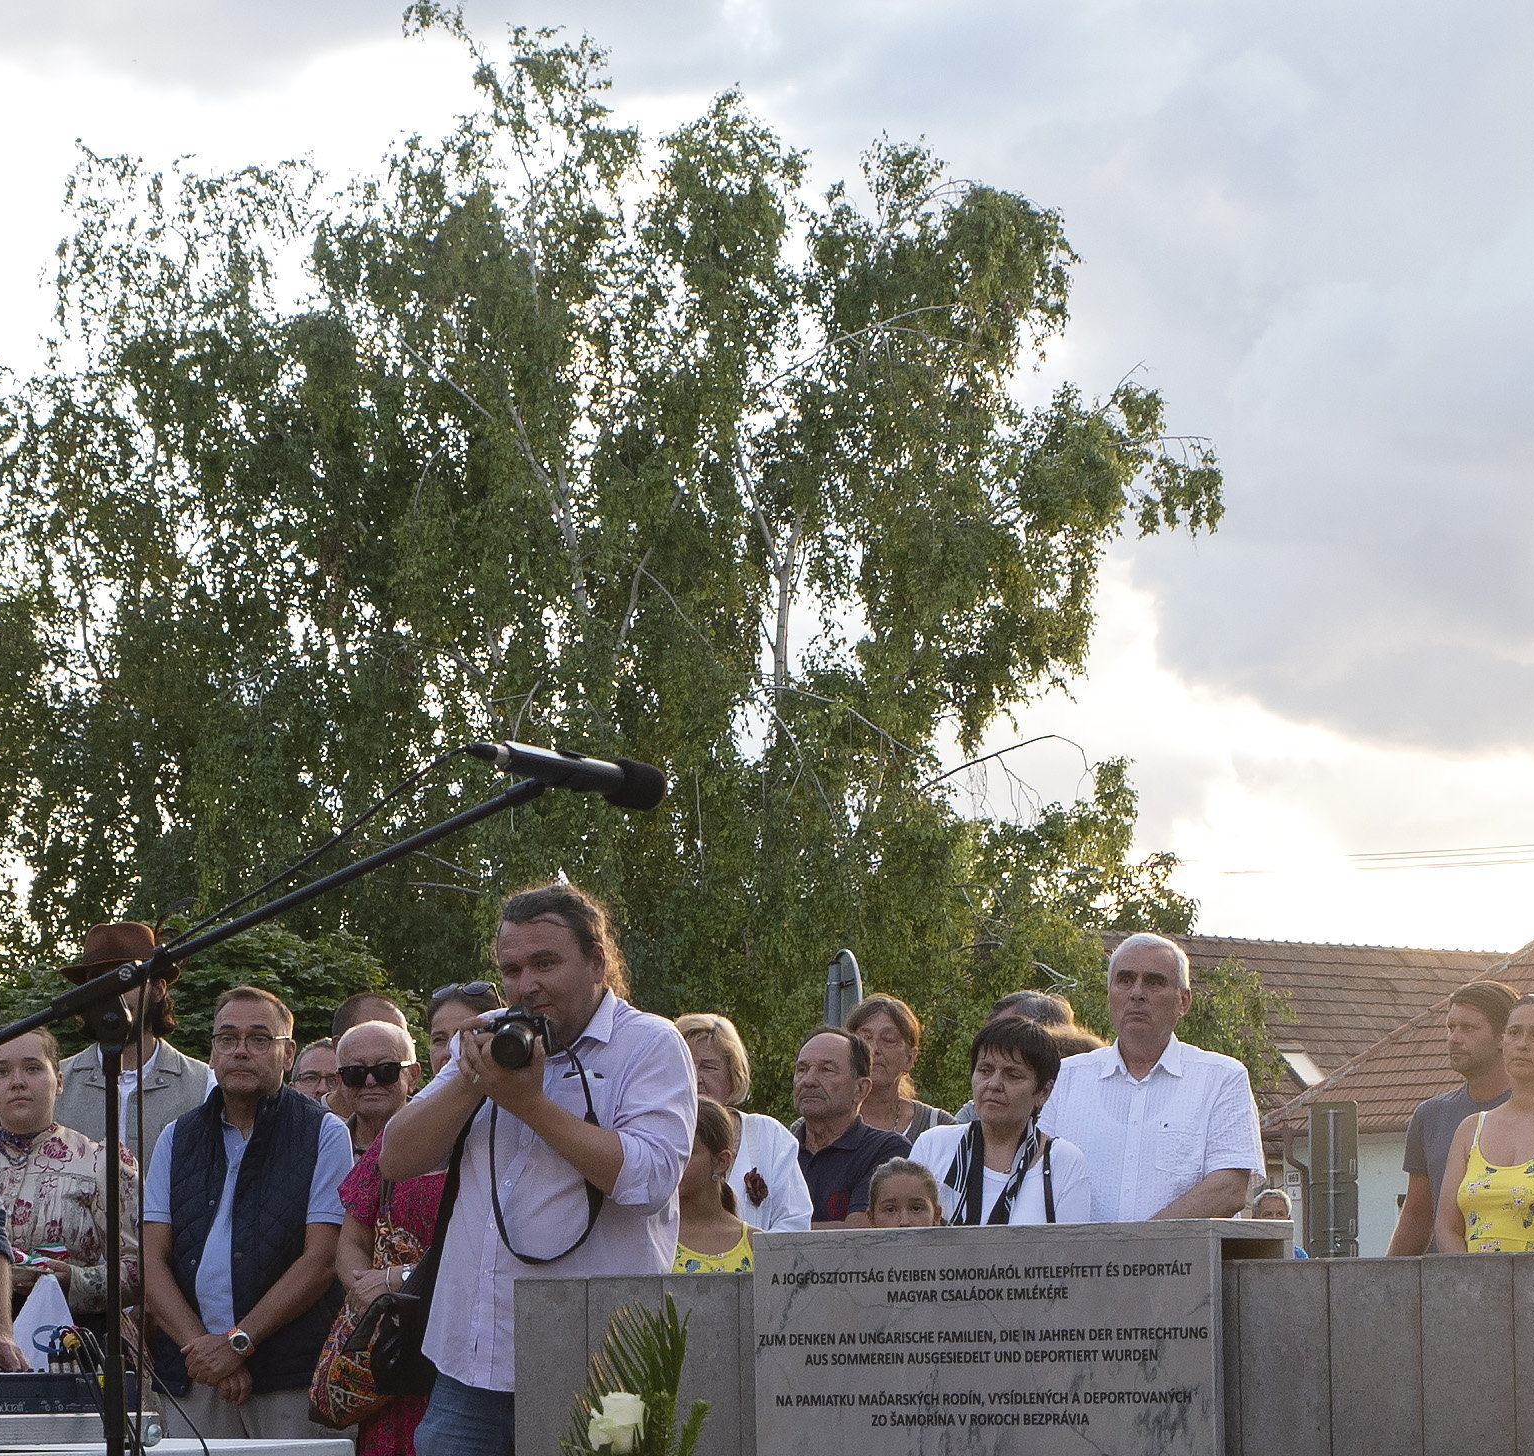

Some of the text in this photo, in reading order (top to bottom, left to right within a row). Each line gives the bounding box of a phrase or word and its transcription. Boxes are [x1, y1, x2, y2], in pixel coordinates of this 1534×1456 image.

[771, 1260, 1192, 1286] A JOGFOSZTOTTSÁG ÉVEIBEN SOMORJÁRÓL KITELEPÍTETT ÉS DEPORTÁLT
[887, 1284, 1068, 1303] MAGYAR CSALÁDOK EMLÉKÉRE
[759, 1327, 1208, 1347] ZUM DENKEN AN UNGARISCHE FAMILIEN, DIE IN JAHREN DER ENTRECHTUNG
[805, 1349, 1158, 1367] AUS SOMMEREIN AUSGESIEDELT UND DEPORTIERT WURDEN
[776, 1388, 1192, 1407] NA PAMIATKU MAĎARSKÝCH RODÍN, VYSÍDLENÝCH A DEPORTOVANÝCH
[871, 1410, 1089, 1427] ZO ŠAMORÍNA V ROKOCH BEZPRÁVIA
